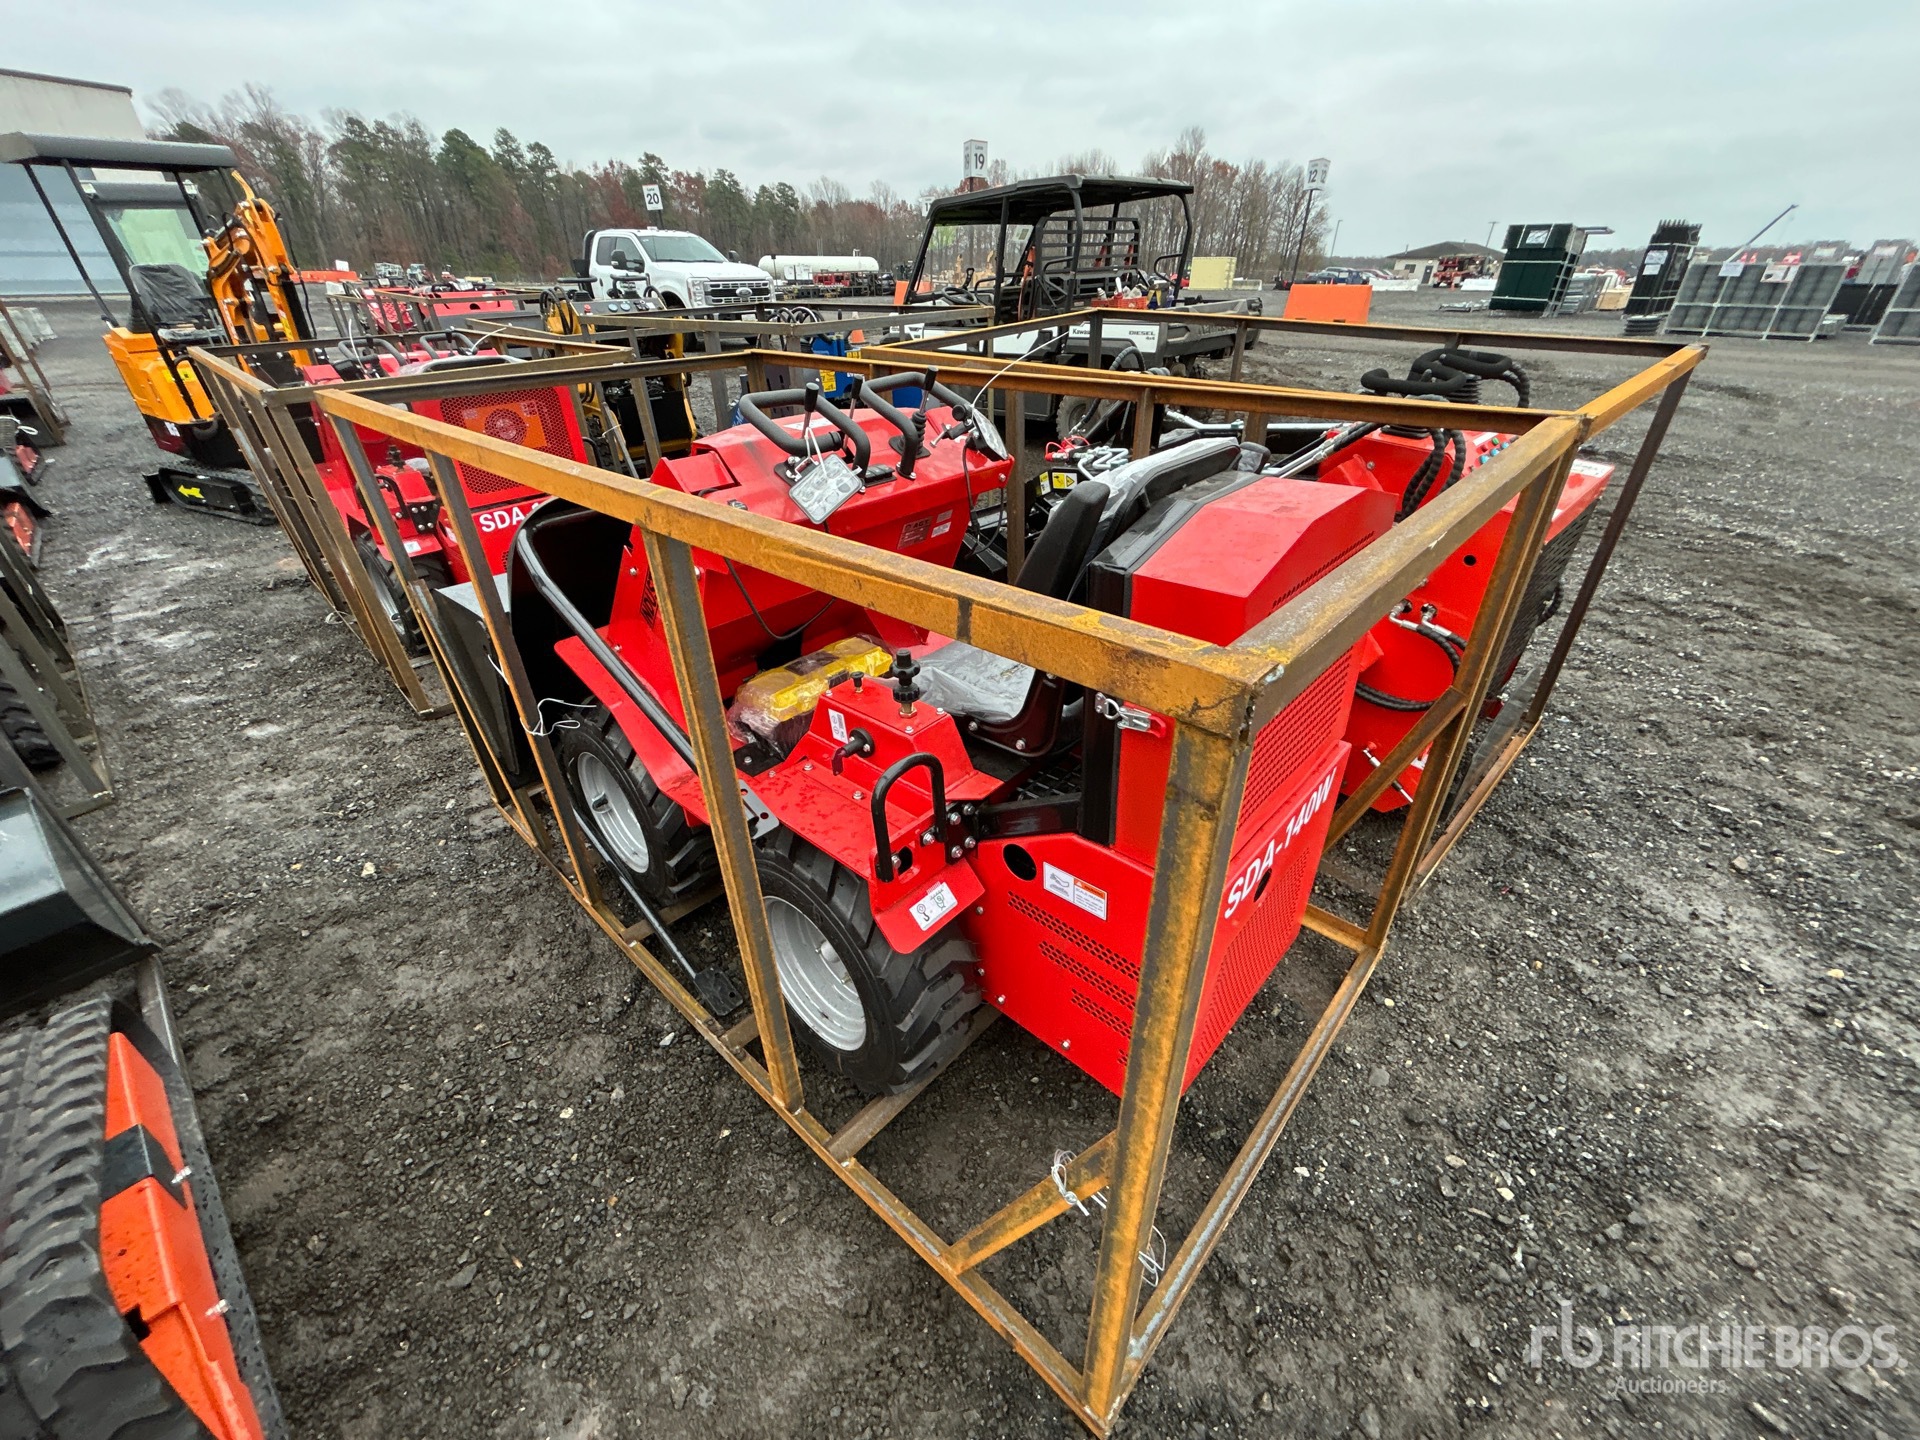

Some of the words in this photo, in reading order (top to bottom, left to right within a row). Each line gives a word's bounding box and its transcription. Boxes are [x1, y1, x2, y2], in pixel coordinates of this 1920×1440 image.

[974, 153, 985, 170] 19
[1308, 169, 1318, 183] 12
[646, 193, 660, 204] 20
[479, 502, 539, 532] SDA
[1224, 767, 1337, 919] SDA-140W
